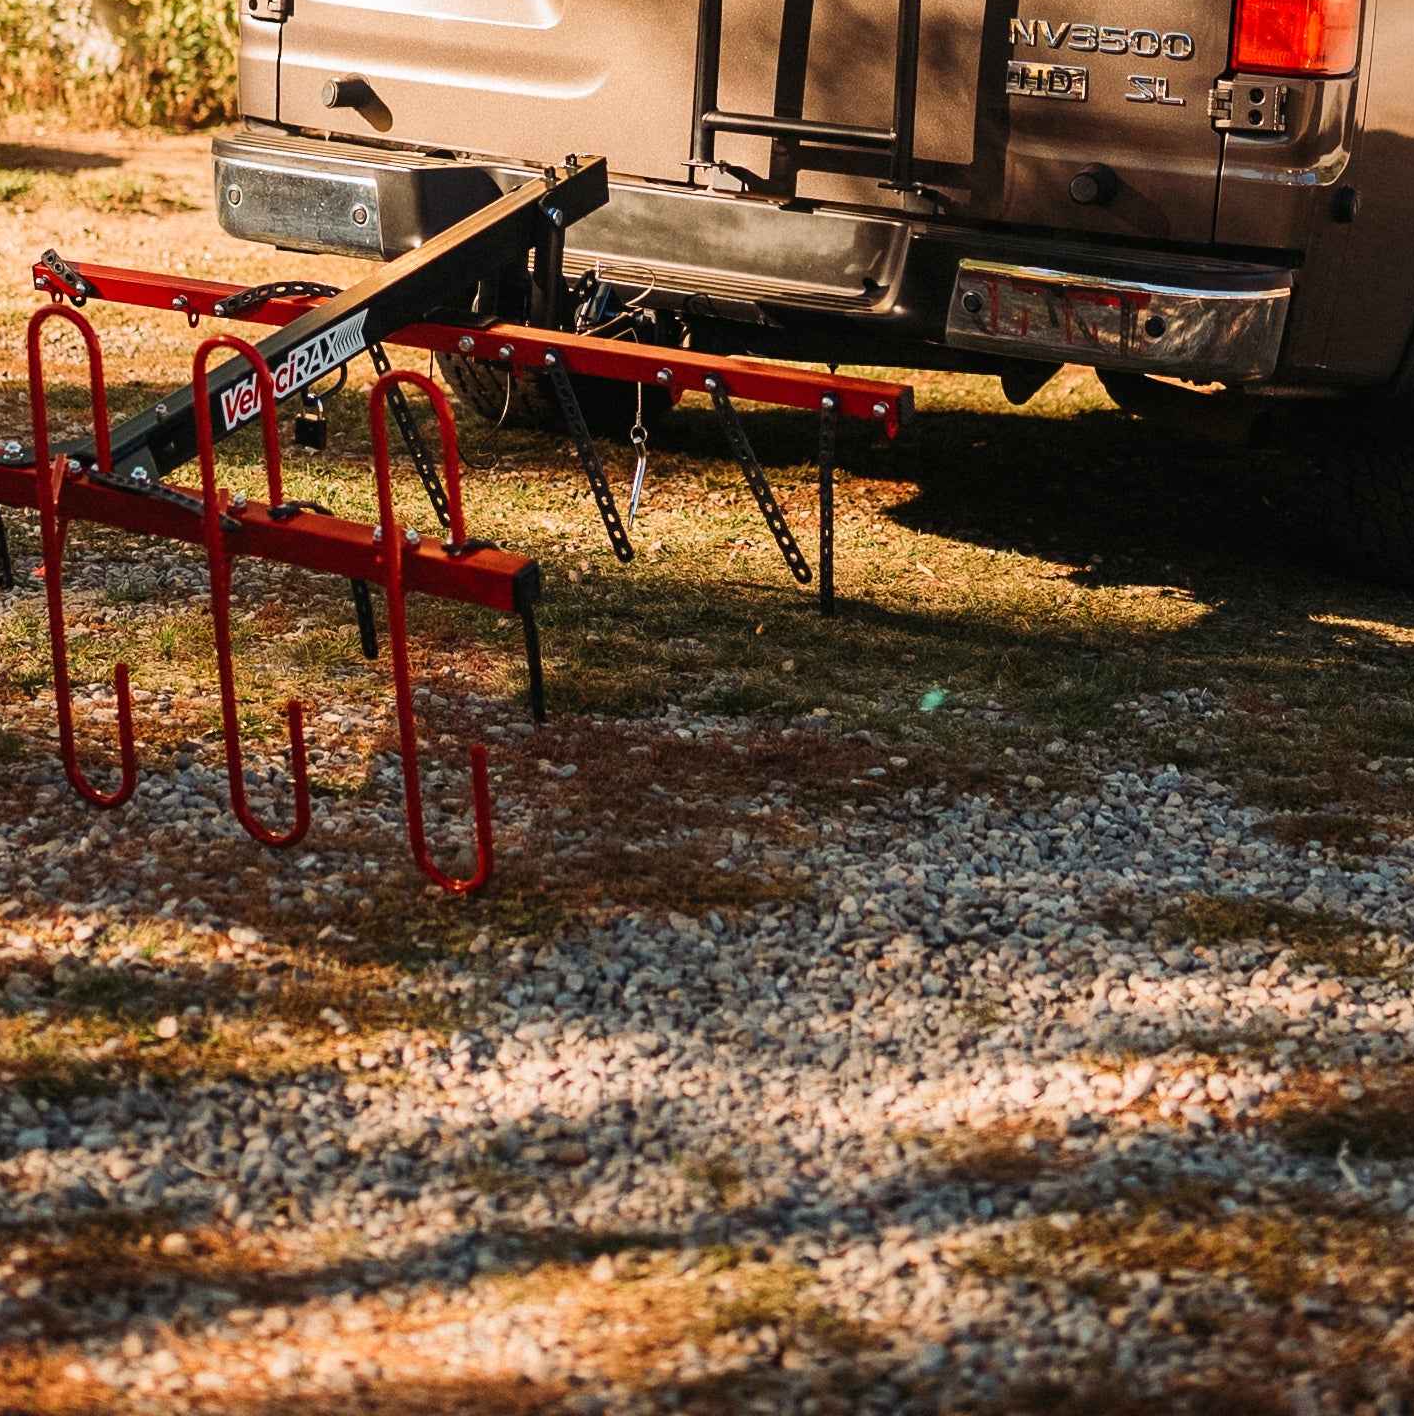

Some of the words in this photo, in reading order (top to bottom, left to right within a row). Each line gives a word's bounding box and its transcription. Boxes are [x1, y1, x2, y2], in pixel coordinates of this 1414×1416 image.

[1009, 18, 1195, 60] NV3500
[1019, 66, 1074, 94] HD
[1124, 74, 1187, 105] SL
[223, 329, 339, 425] VelciRAX
